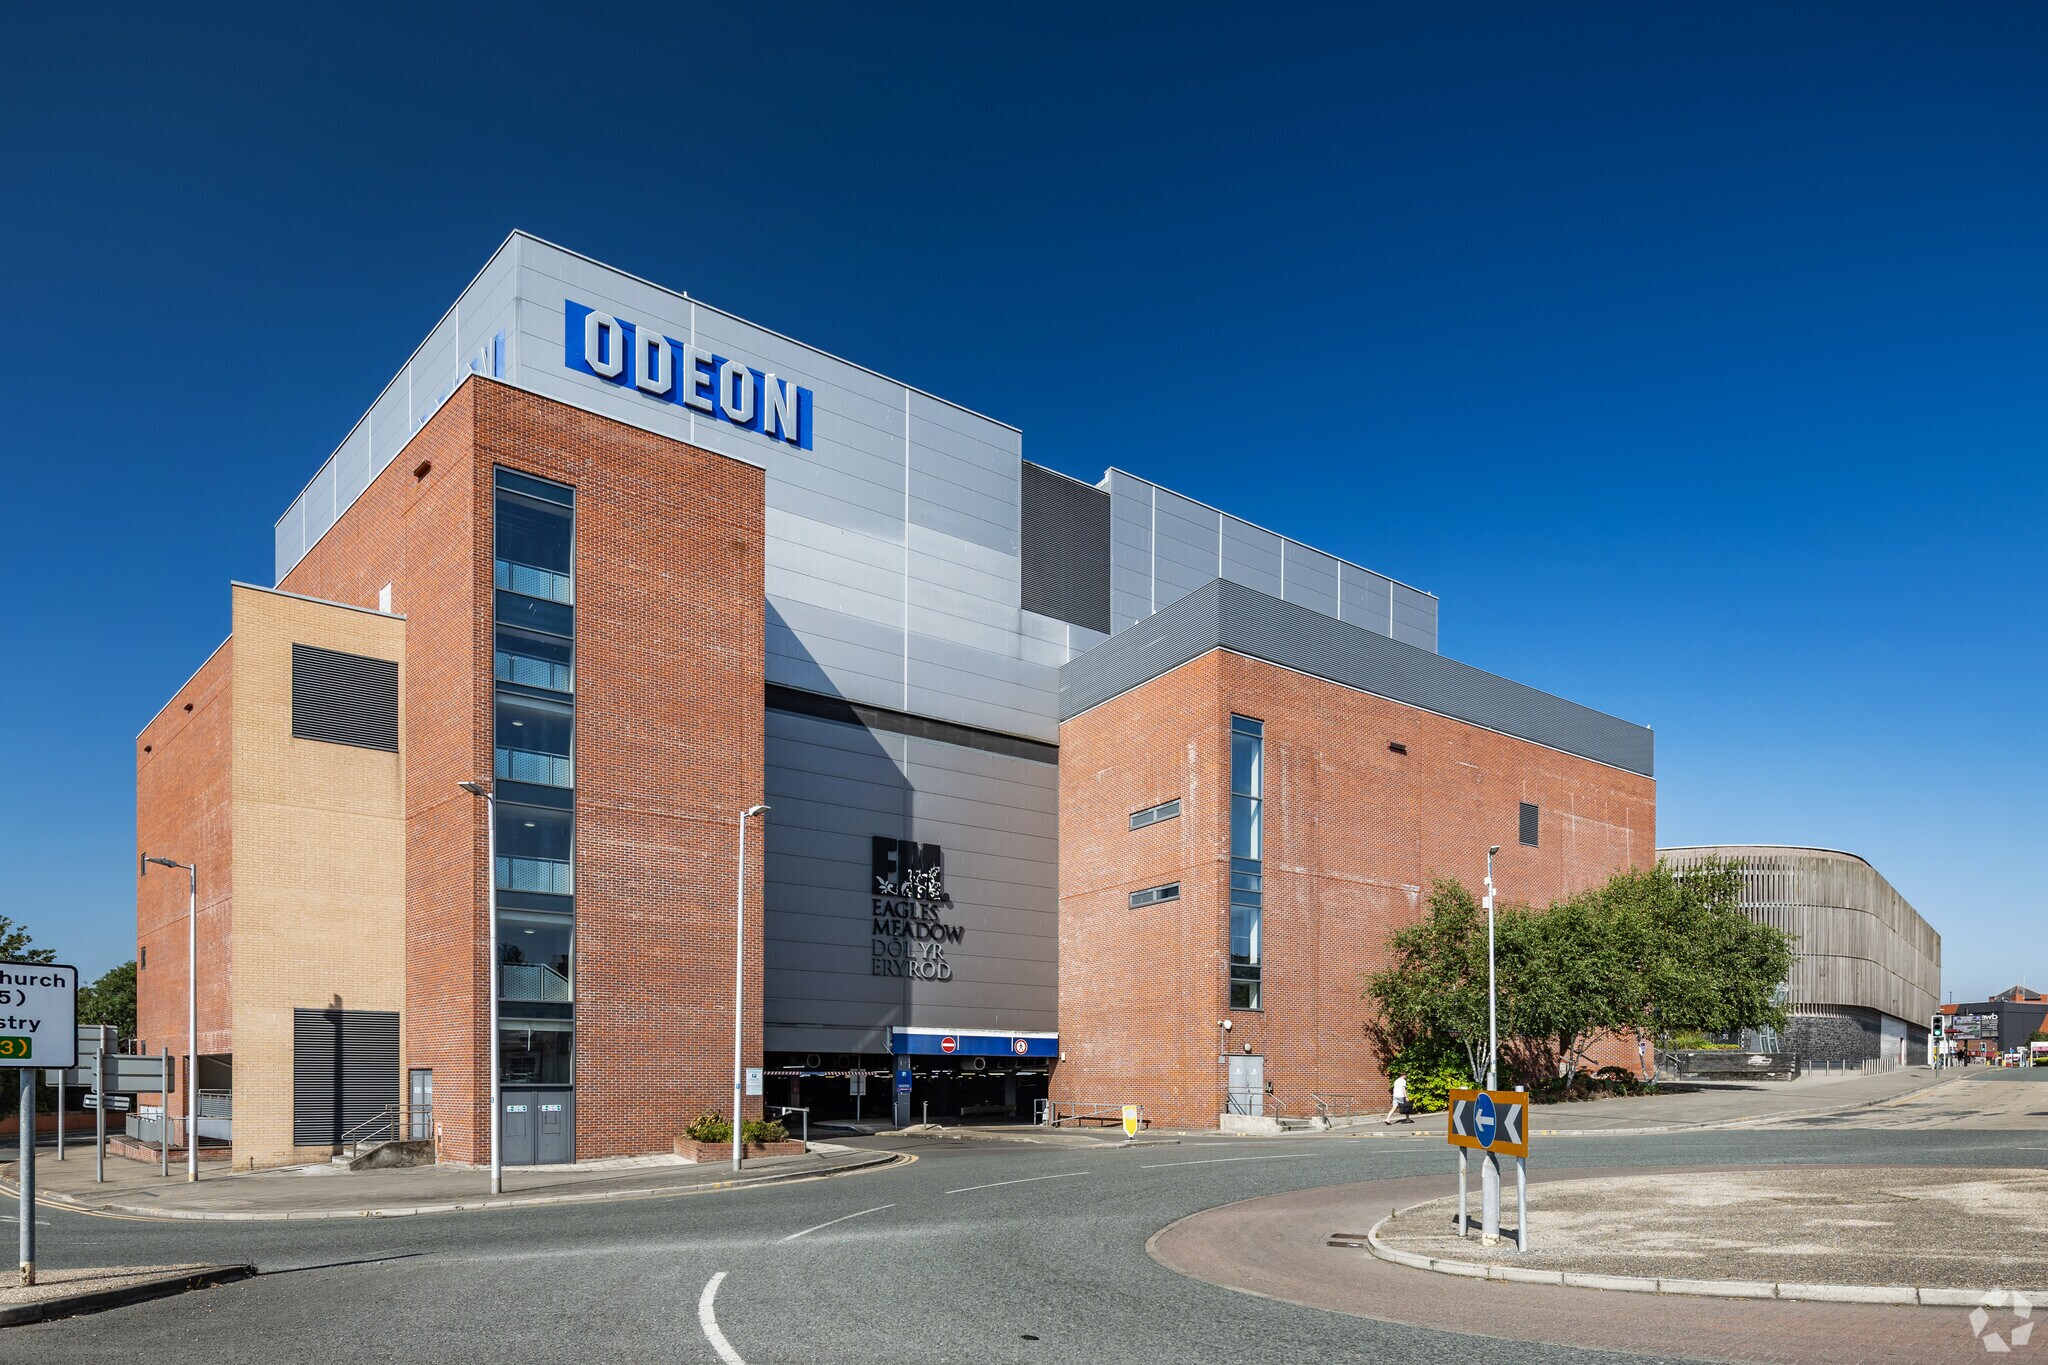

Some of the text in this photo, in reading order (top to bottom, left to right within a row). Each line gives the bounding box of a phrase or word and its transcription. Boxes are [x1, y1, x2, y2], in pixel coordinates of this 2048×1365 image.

[584, 310, 798, 441] ODEON
[872, 899, 938, 921] EAGLES
[872, 918, 964, 942] MEADOW
[872, 937, 944, 960] DÔL YR
[872, 958, 951, 979] ERYROD
